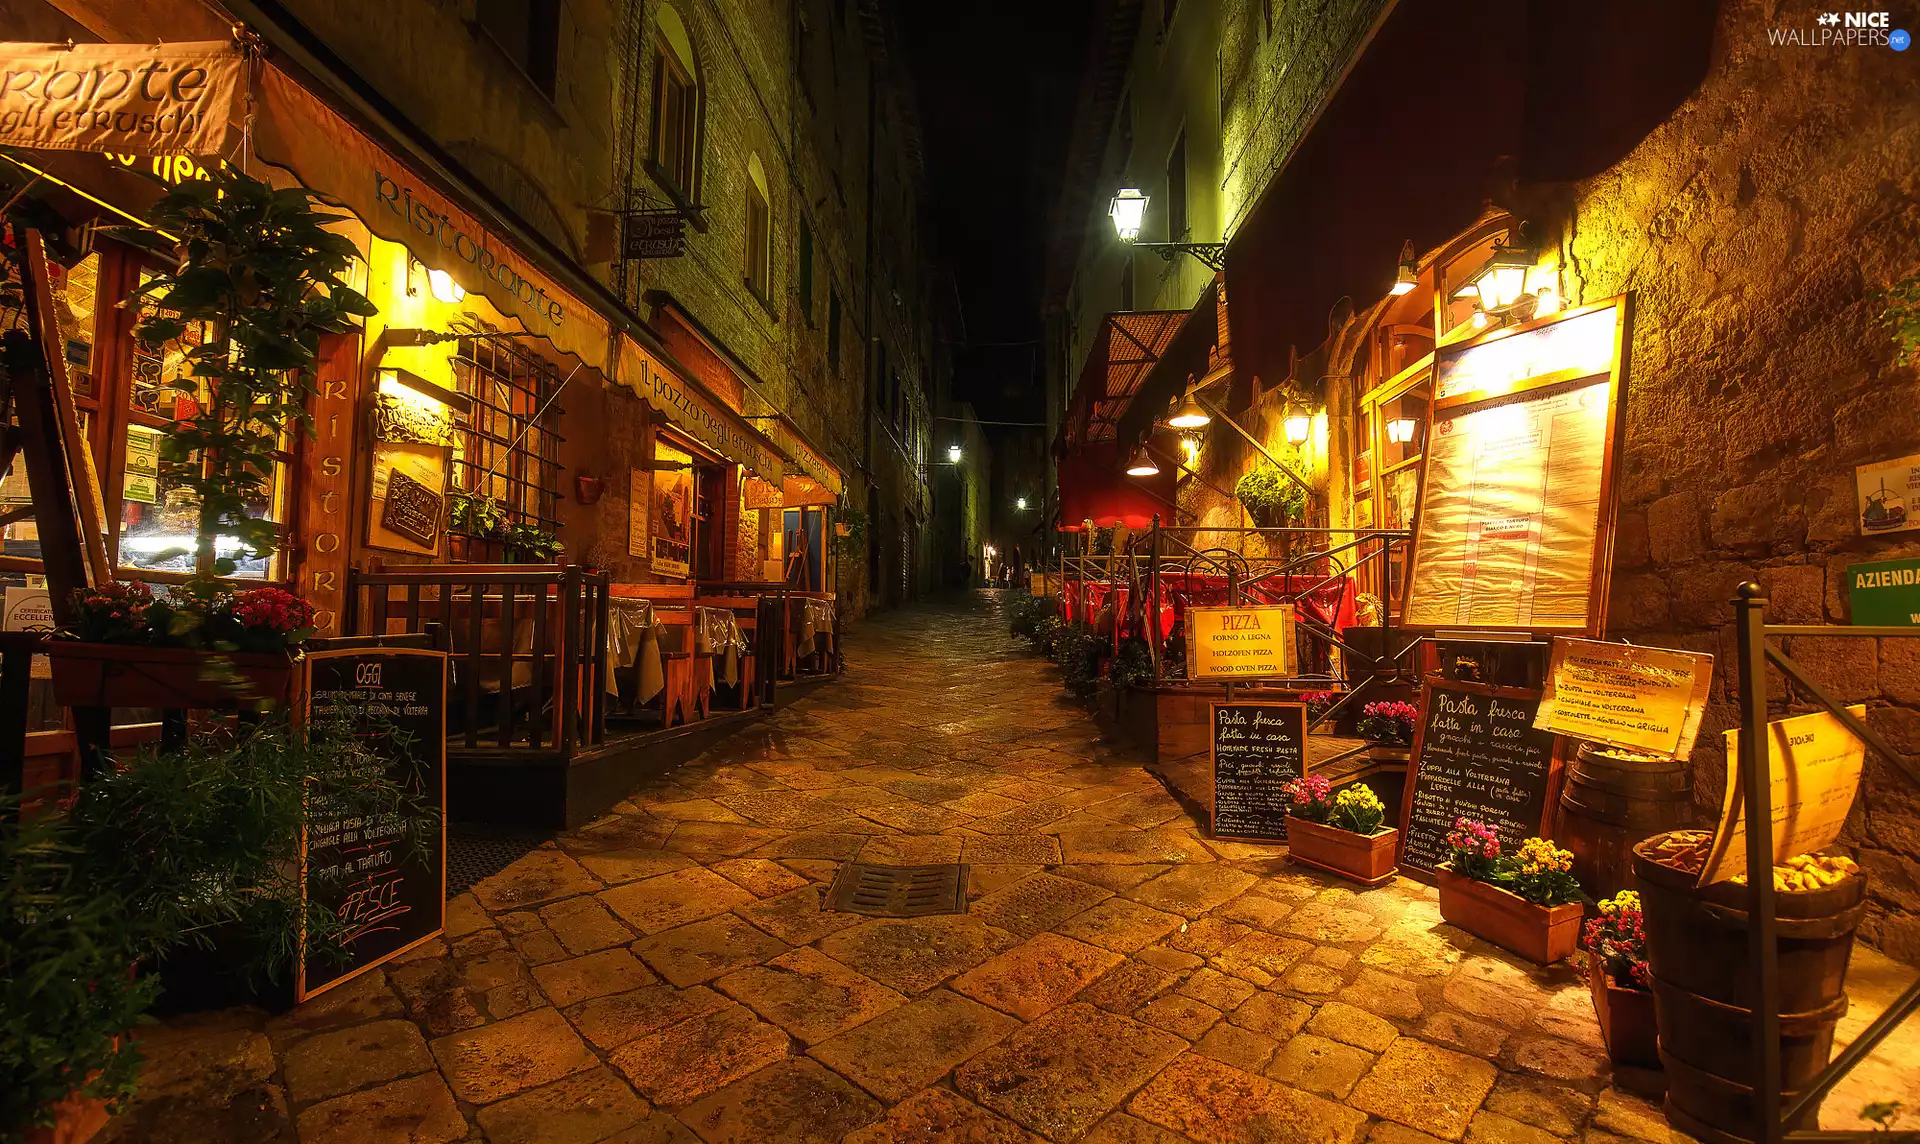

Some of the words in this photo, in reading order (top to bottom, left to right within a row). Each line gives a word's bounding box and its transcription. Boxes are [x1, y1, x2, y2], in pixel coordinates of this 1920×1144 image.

[1222, 614, 1261, 630] PIZZA
[356, 663, 382, 685] OGGI
[1593, 689, 1636, 700] VOLTERRANA
[1438, 694, 1479, 716] Pasta
[1487, 699, 1527, 724] fresca
[1601, 703, 1645, 714] VOLTERRANA
[1218, 709, 1248, 725] Pasta
[1252, 711, 1285, 730] fresca
[1431, 713, 1461, 732] fatta
[1470, 720, 1484, 733] in
[1493, 726, 1523, 738] casa
[1218, 727, 1245, 742] fatta
[1249, 732, 1262, 740] in
[1266, 732, 1291, 742] casa
[1637, 722, 1669, 734] GRIGLIA
[1420, 762, 1442, 773] ZUPPA
[1465, 769, 1510, 786] VOLTERRANA
[1466, 781, 1485, 791] ALLA
[1418, 790, 1444, 803] RISOTTO
[1454, 807, 1484, 820] RICOTTA
[1411, 829, 1436, 841] FILETTO
[357, 850, 392, 871] TARTUFO
[338, 878, 405, 923] PESCE
